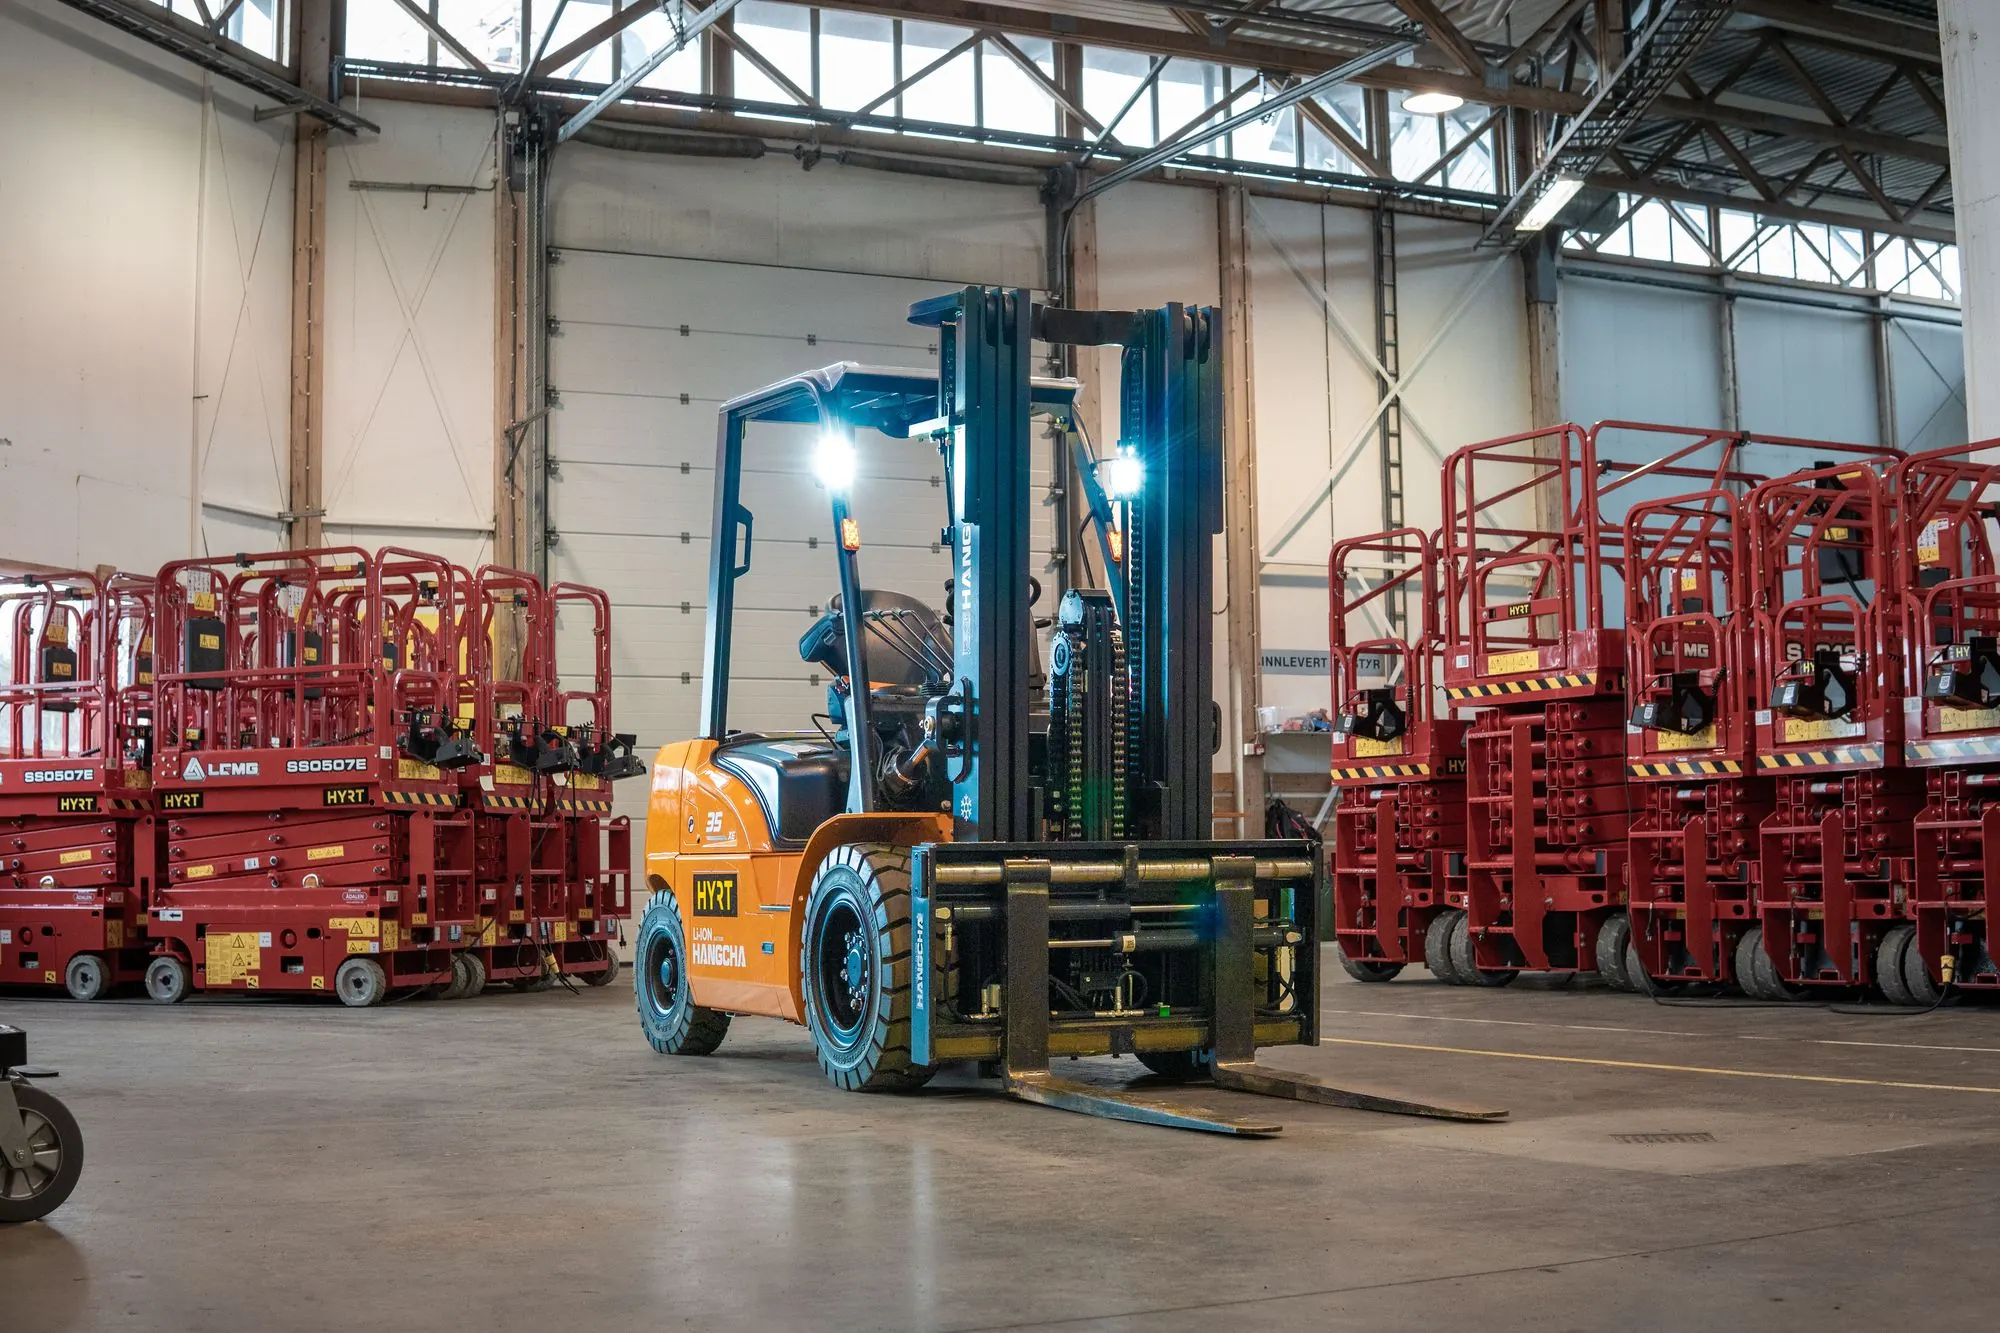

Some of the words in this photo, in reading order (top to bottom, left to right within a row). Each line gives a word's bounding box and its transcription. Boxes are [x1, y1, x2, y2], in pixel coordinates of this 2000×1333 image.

[961, 524, 972, 610] HANG
[1509, 604, 1529, 616] HYRT
[1661, 641, 1709, 657] LMG
[1955, 646, 1970, 658] HY
[1261, 656, 1328, 669] INNLEVERT
[1803, 661, 1815, 673] HY
[1448, 759, 1466, 773] HY
[164, 793, 200, 808] HYRT
[327, 789, 364, 804] HYRT
[61, 798, 93, 811] HYRT
[706, 811, 723, 832] 35
[697, 880, 733, 911] HYRT
[692, 943, 747, 968] HANGCHA
[916, 912, 924, 1010] HANGCHA
